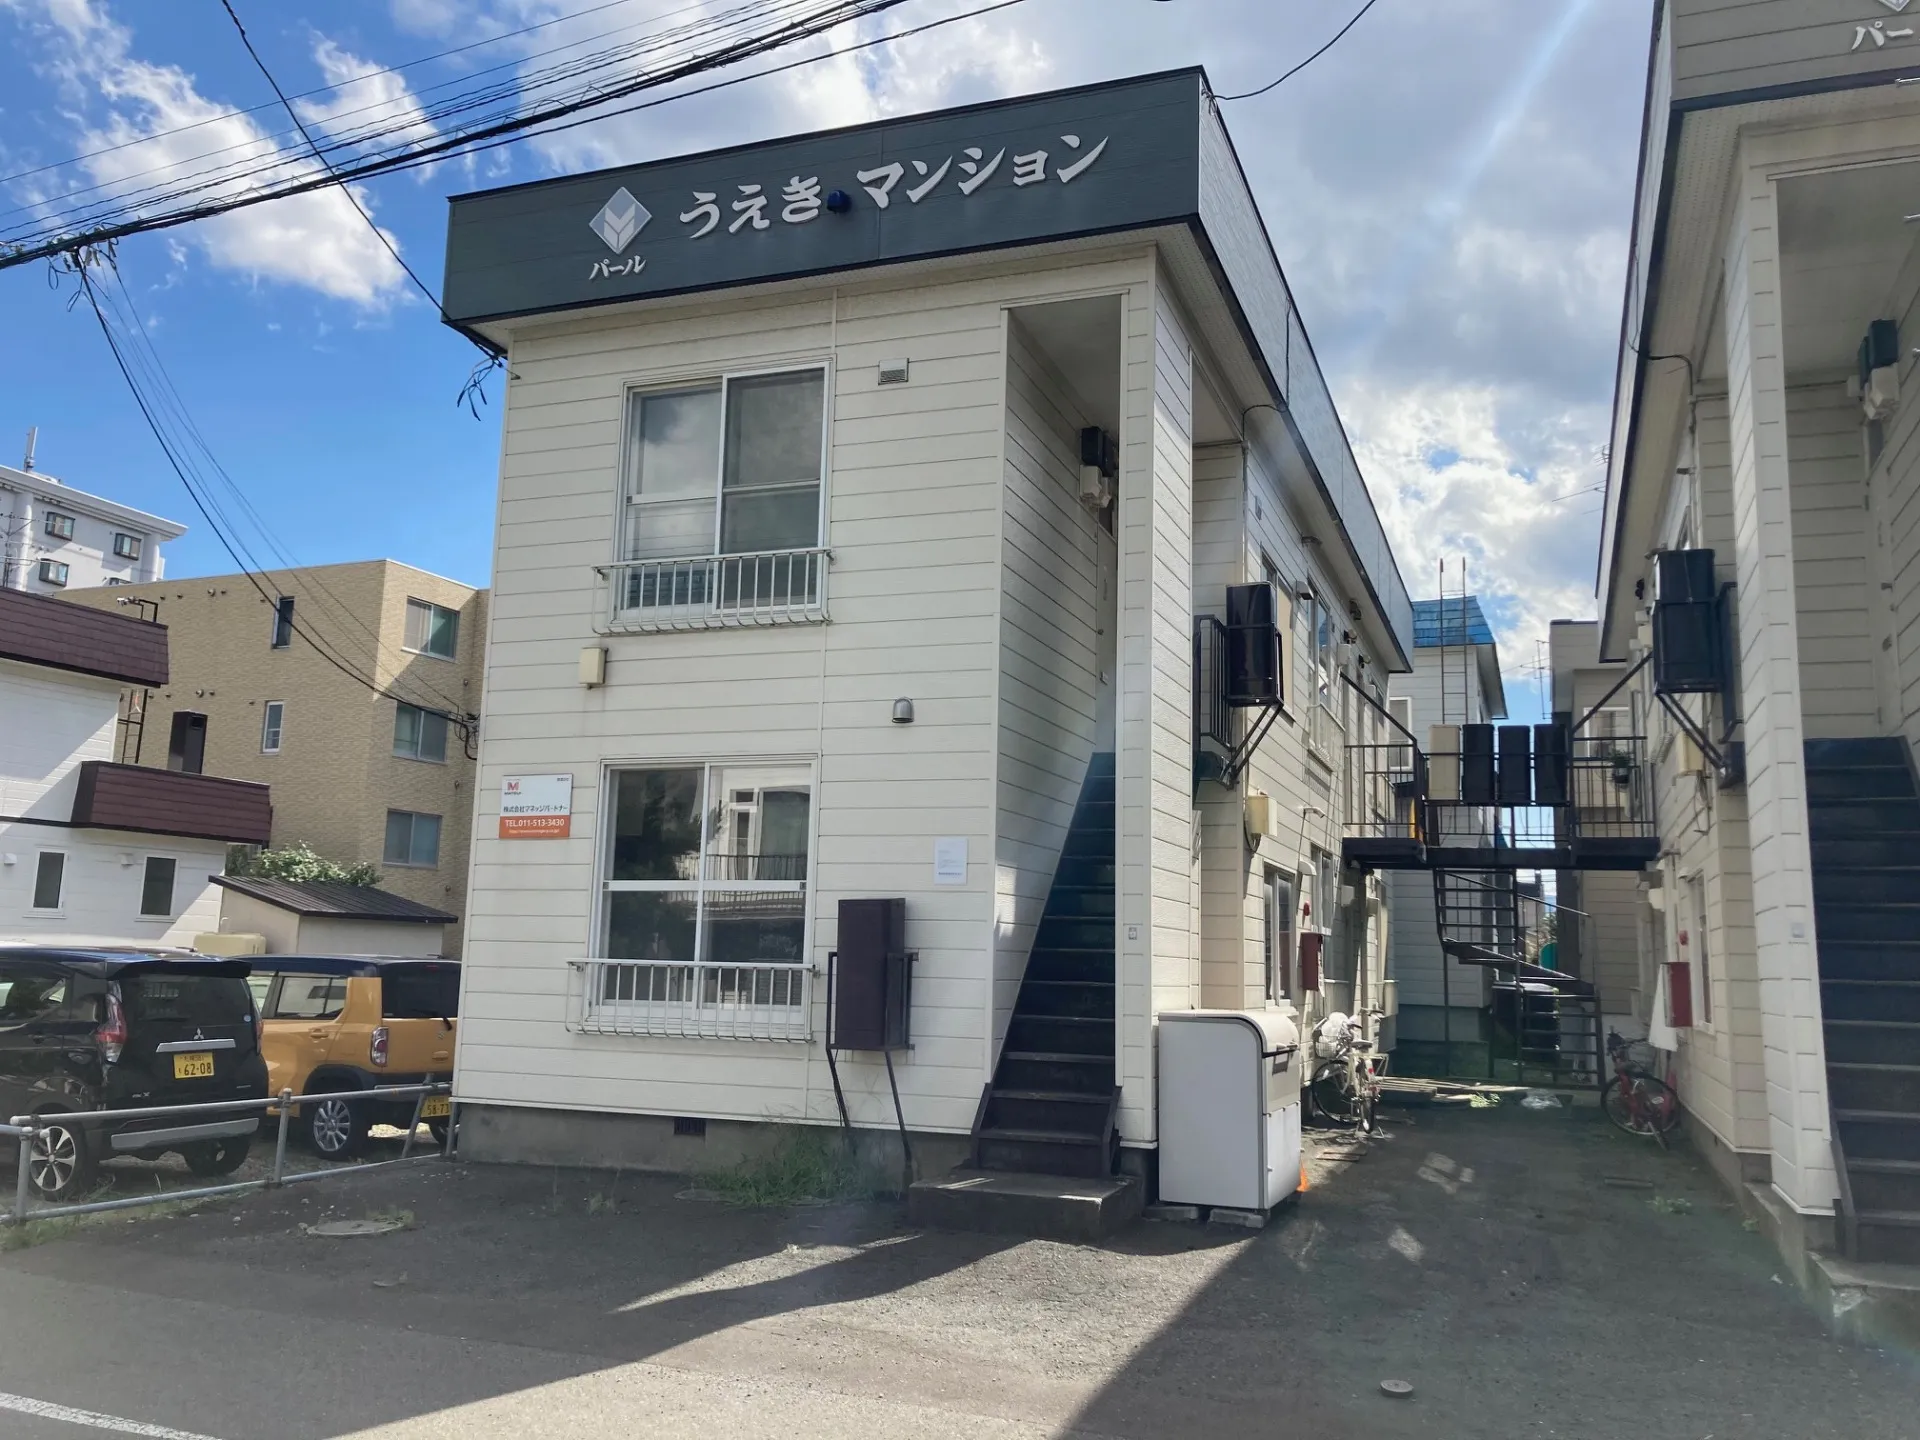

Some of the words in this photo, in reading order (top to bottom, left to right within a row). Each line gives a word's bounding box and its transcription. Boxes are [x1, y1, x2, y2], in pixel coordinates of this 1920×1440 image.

[1851, 20, 1920, 51] パー
[679, 175, 822, 239] うえき
[856, 134, 1109, 209] マンション
[588, 255, 647, 281] パール
